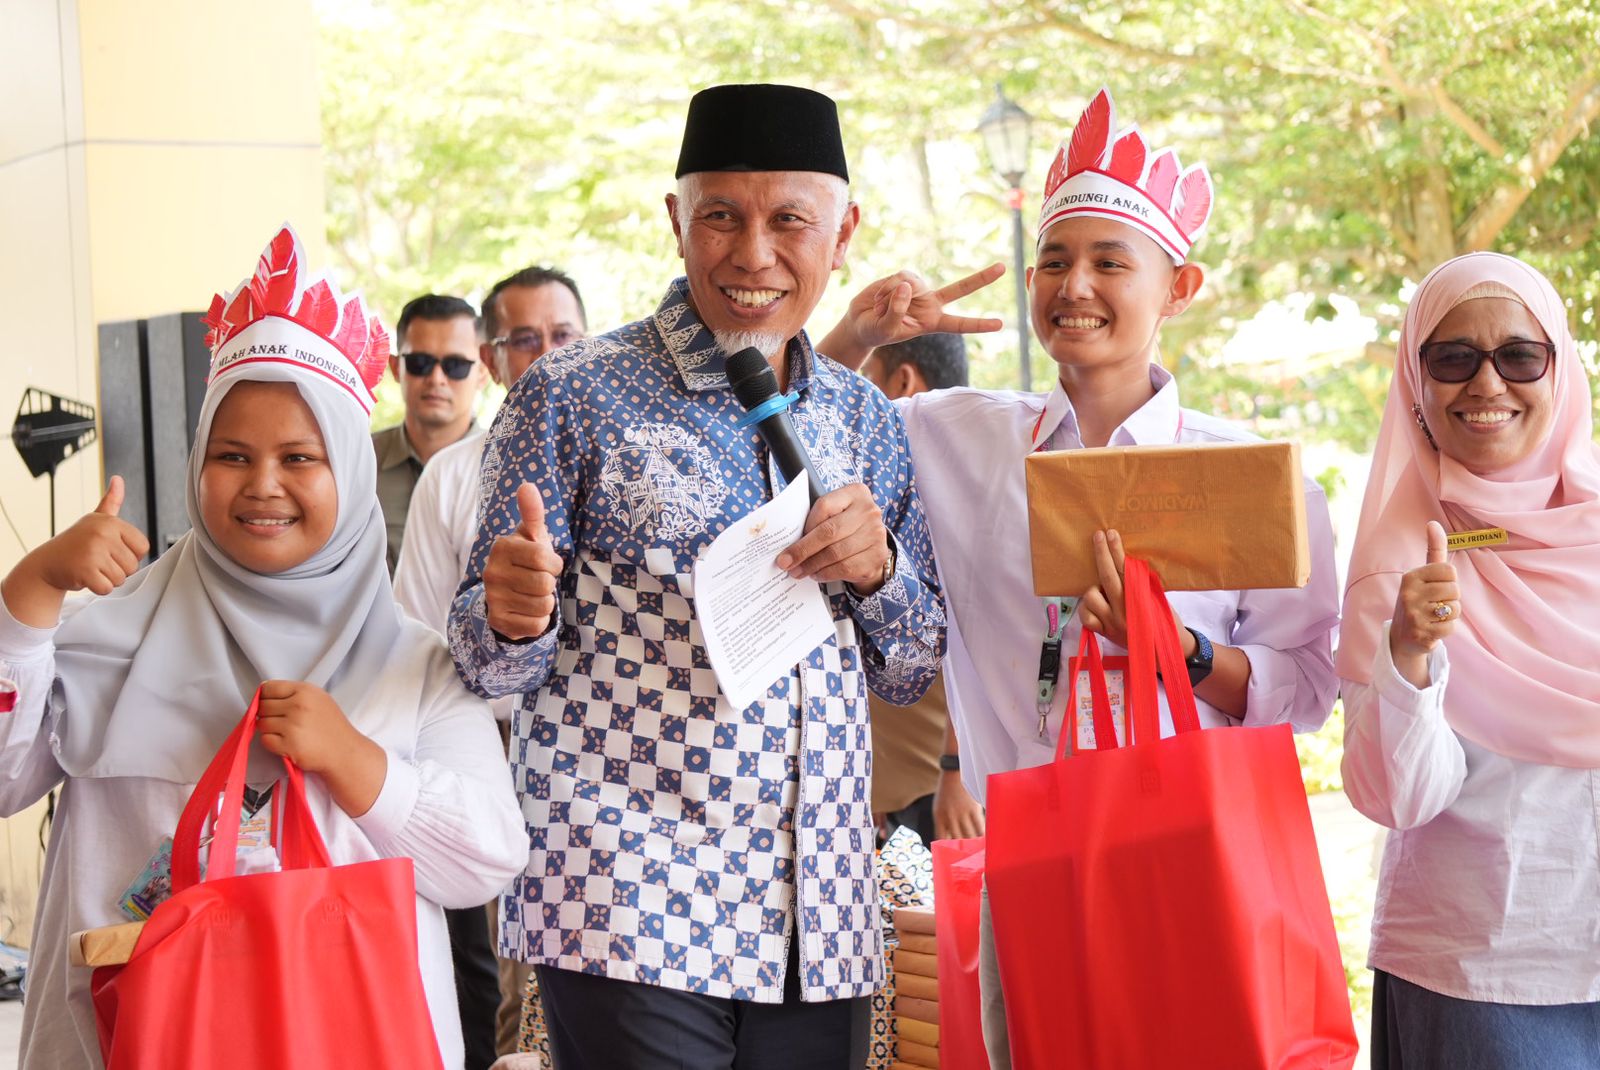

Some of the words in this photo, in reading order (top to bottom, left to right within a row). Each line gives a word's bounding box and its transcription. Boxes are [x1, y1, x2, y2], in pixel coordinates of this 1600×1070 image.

[1055, 193, 1109, 209] LINDUNGI
[1112, 197, 1150, 218] ANAK
[247, 345, 288, 355] ANAK
[294, 349, 357, 387] INDONESIA
